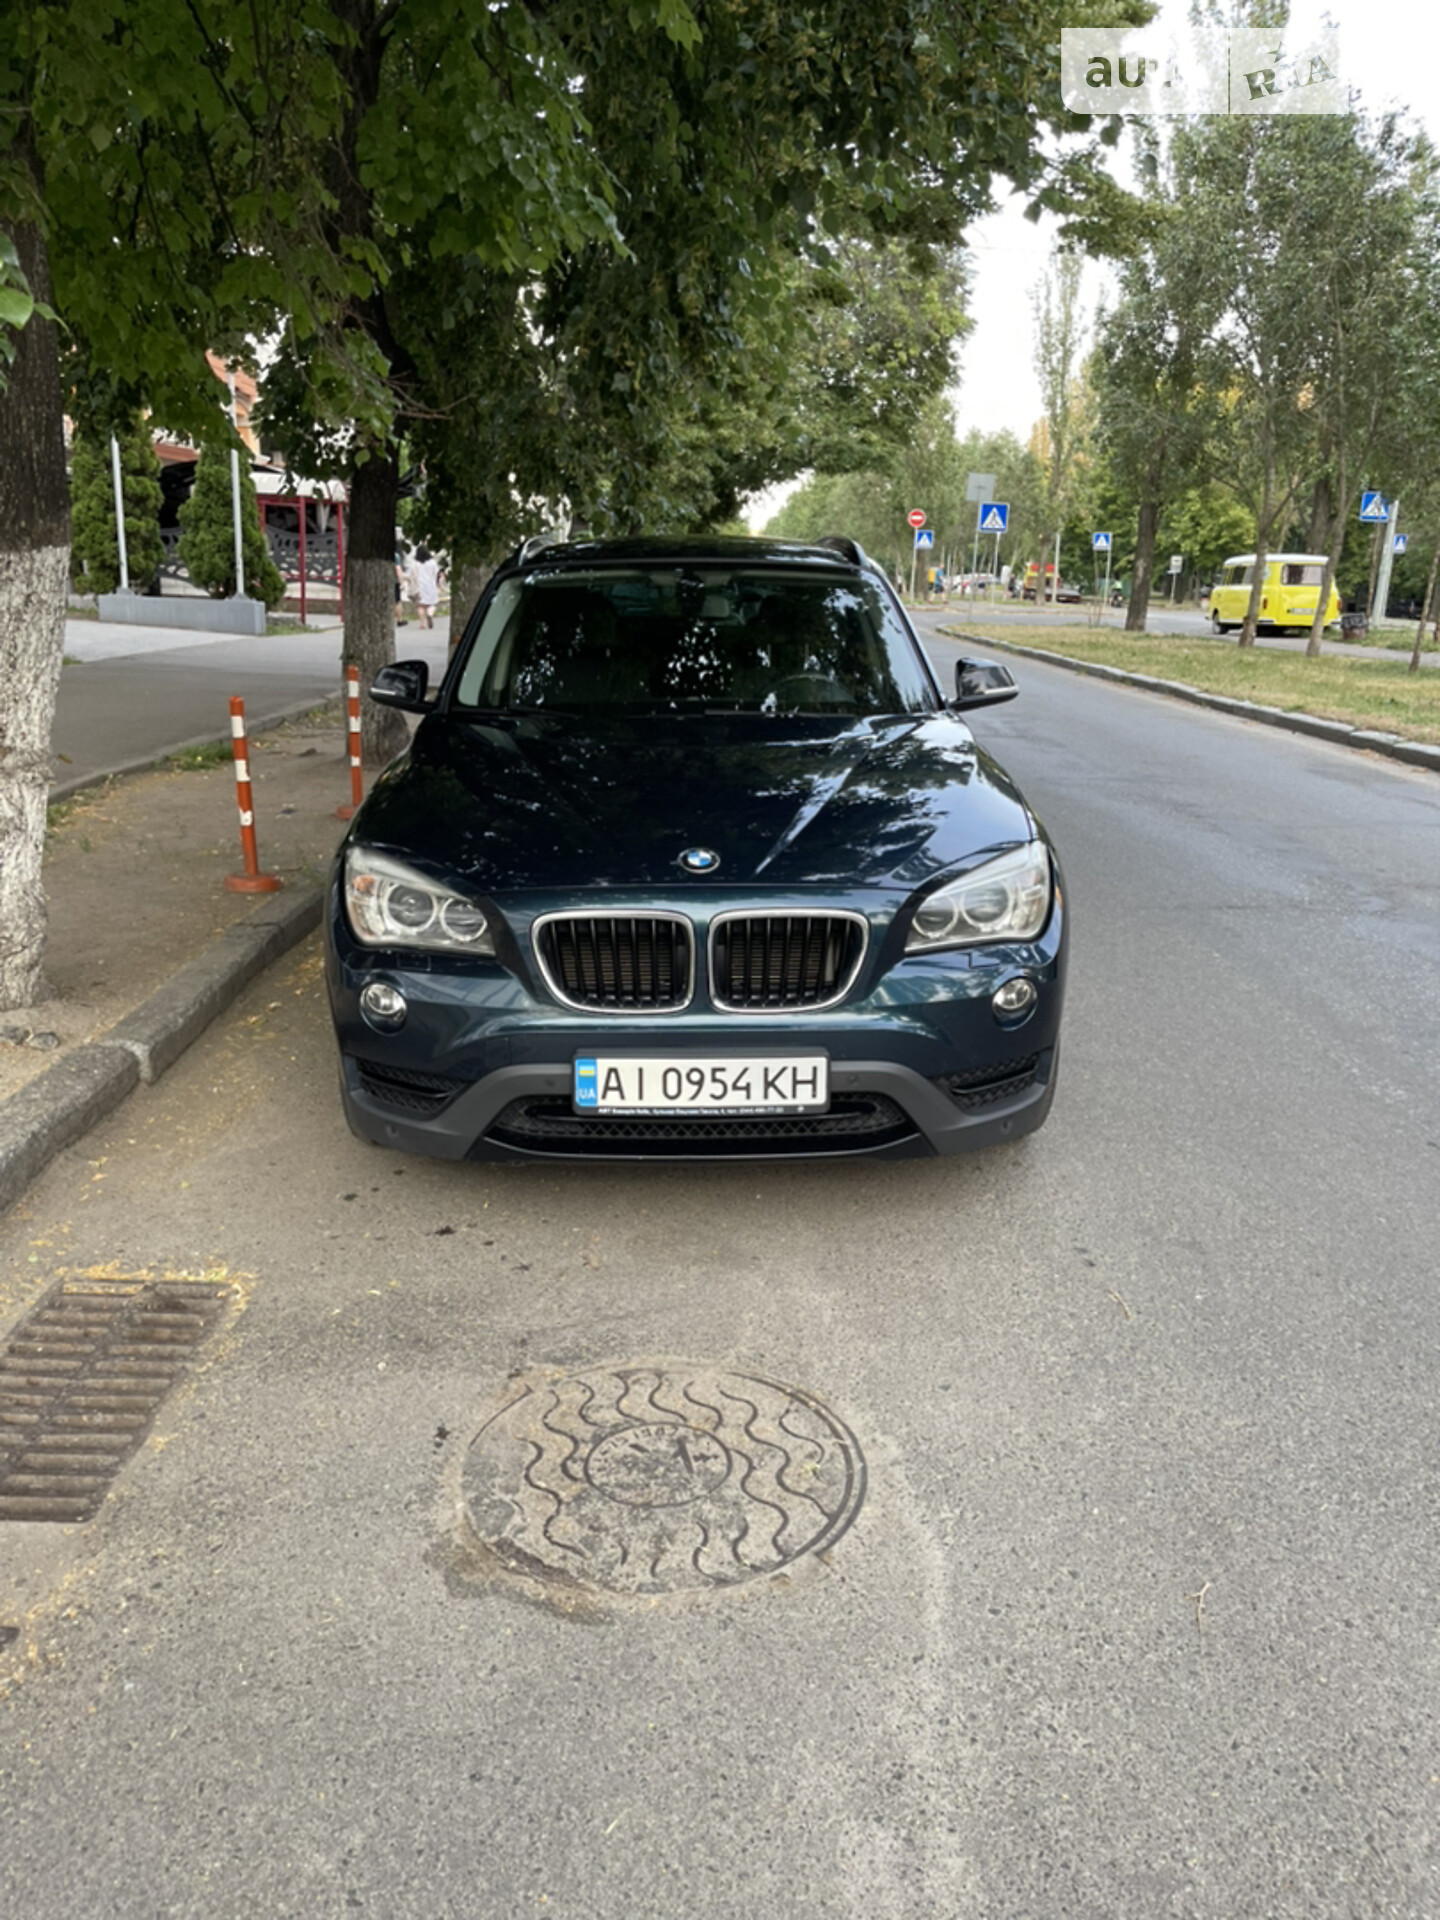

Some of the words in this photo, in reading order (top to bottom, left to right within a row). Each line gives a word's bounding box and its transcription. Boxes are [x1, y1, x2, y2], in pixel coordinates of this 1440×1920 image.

[578, 1088, 596, 1099] UA
[601, 1066, 643, 1101] AI
[661, 1066, 752, 1101] 0954
[763, 1065, 818, 1100] KH
